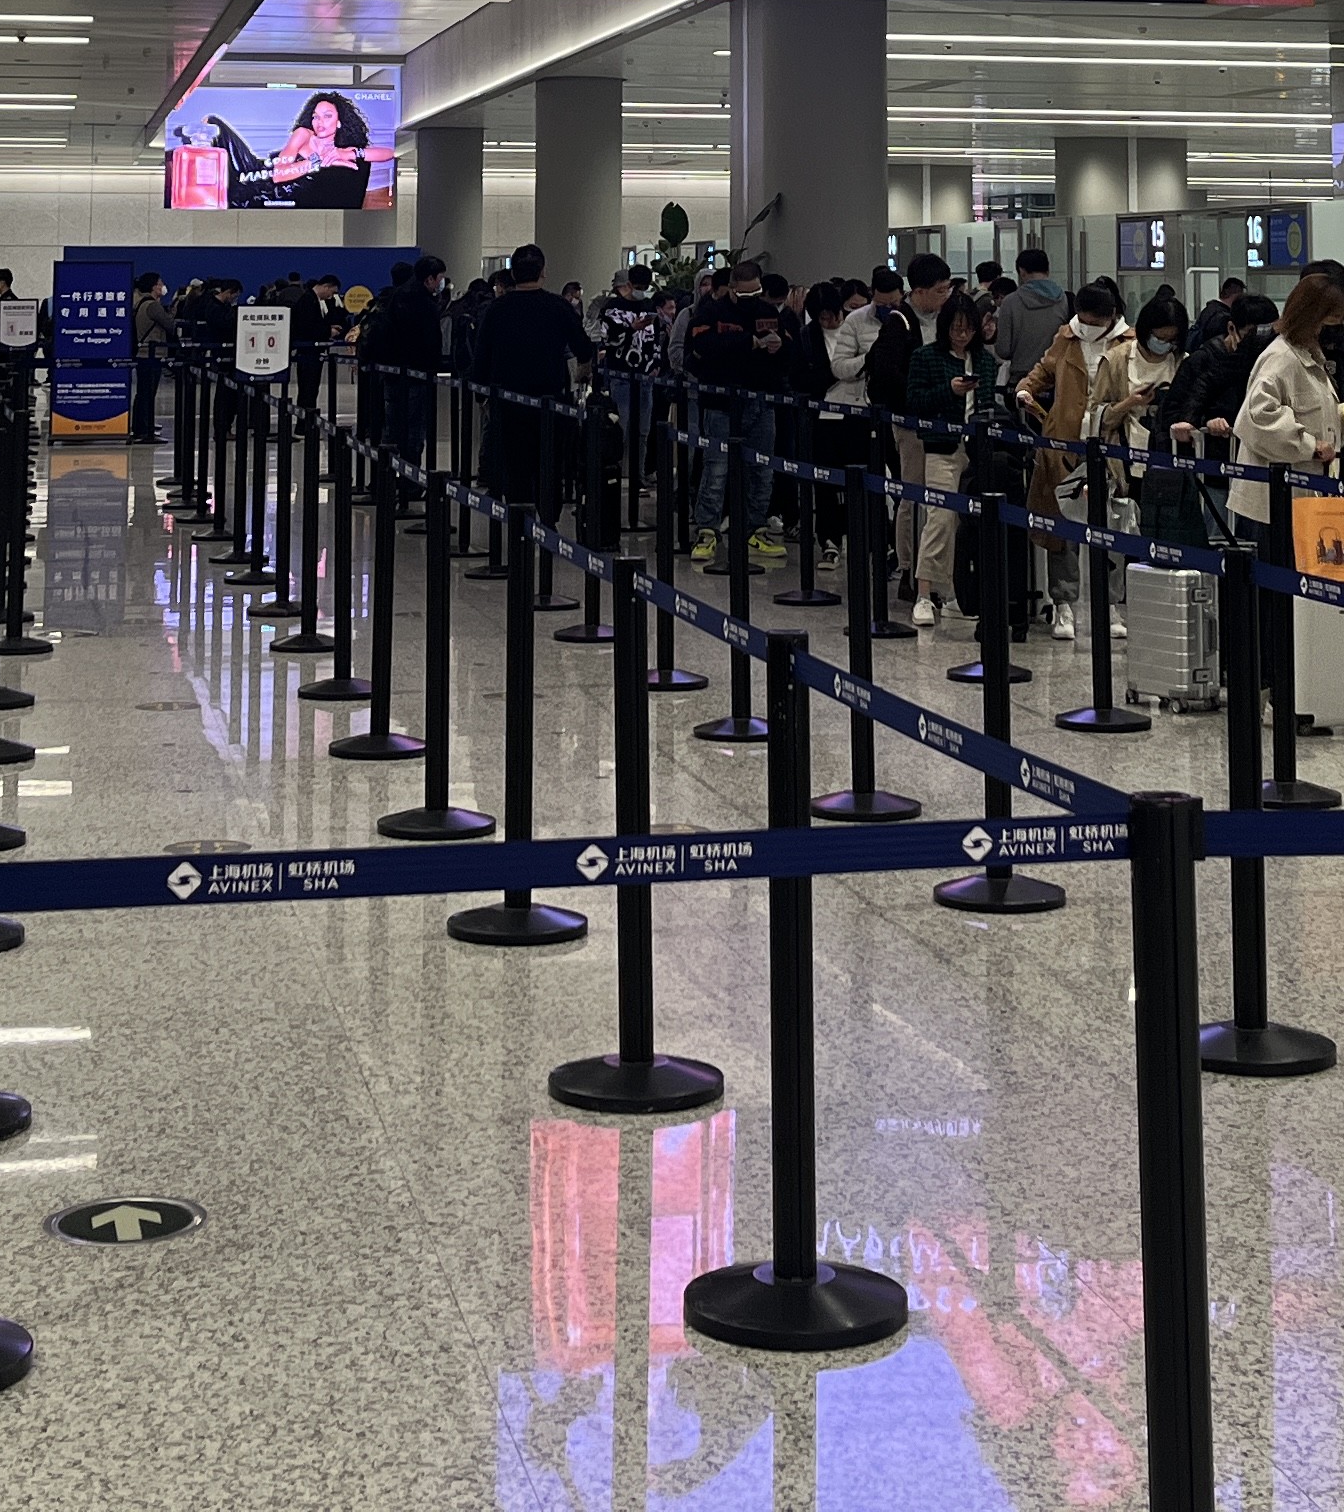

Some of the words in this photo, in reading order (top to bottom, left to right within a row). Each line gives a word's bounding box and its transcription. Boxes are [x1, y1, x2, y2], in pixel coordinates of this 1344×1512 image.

[354, 92, 392, 101] CHANEL
[1150, 220, 1165, 248] 15
[1247, 215, 1264, 245] 16
[998, 826, 1056, 844] 上海机场
[1069, 824, 1129, 839] 虹桥机场
[614, 845, 676, 862] 上海机场
[689, 841, 753, 858] 虹桥机场
[998, 842, 1056, 857] AVINEX
[1082, 840, 1115, 853] SHA
[208, 863, 274, 880] 上海机场
[287, 859, 355, 877] 虹桥机场
[614, 861, 676, 876] AVINEX
[704, 858, 738, 872] SHA
[208, 879, 273, 894] AVINEX
[303, 877, 339, 891] SHA
